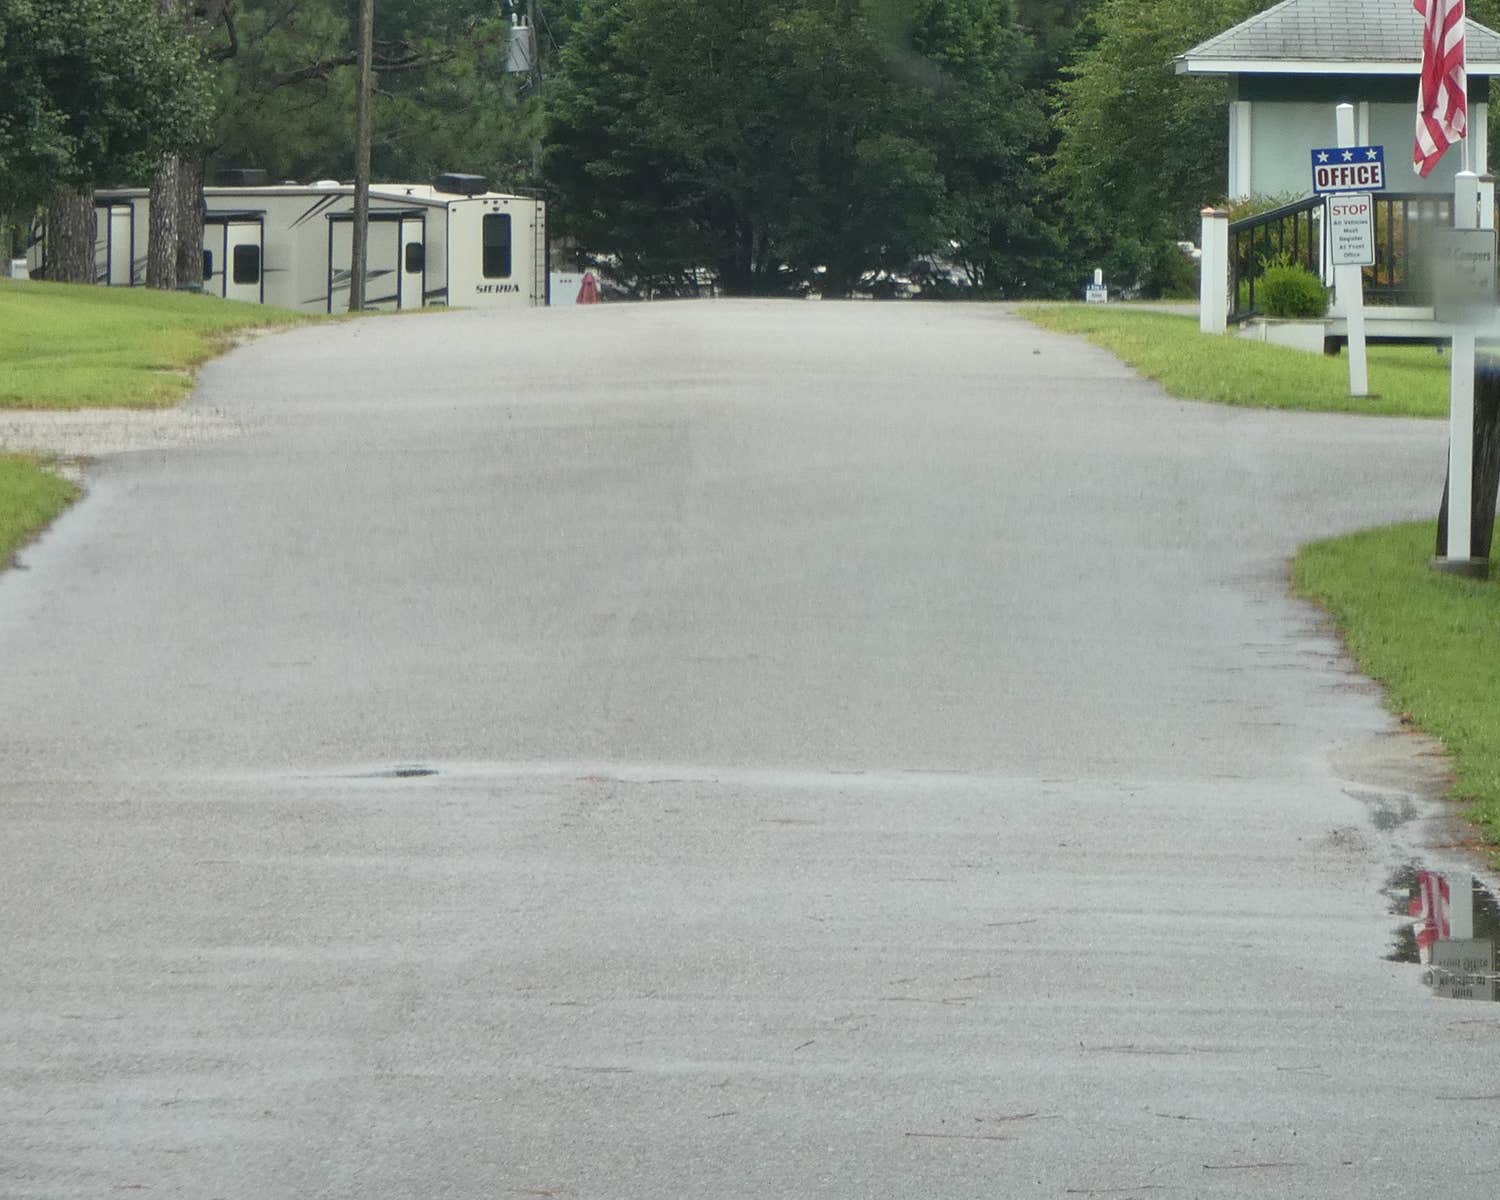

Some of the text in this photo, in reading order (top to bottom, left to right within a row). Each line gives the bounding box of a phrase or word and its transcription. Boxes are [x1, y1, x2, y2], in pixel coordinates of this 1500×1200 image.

[1318, 166, 1380, 187] OFFICE
[1333, 204, 1368, 216] STOP
[476, 284, 519, 294] SIERRA
